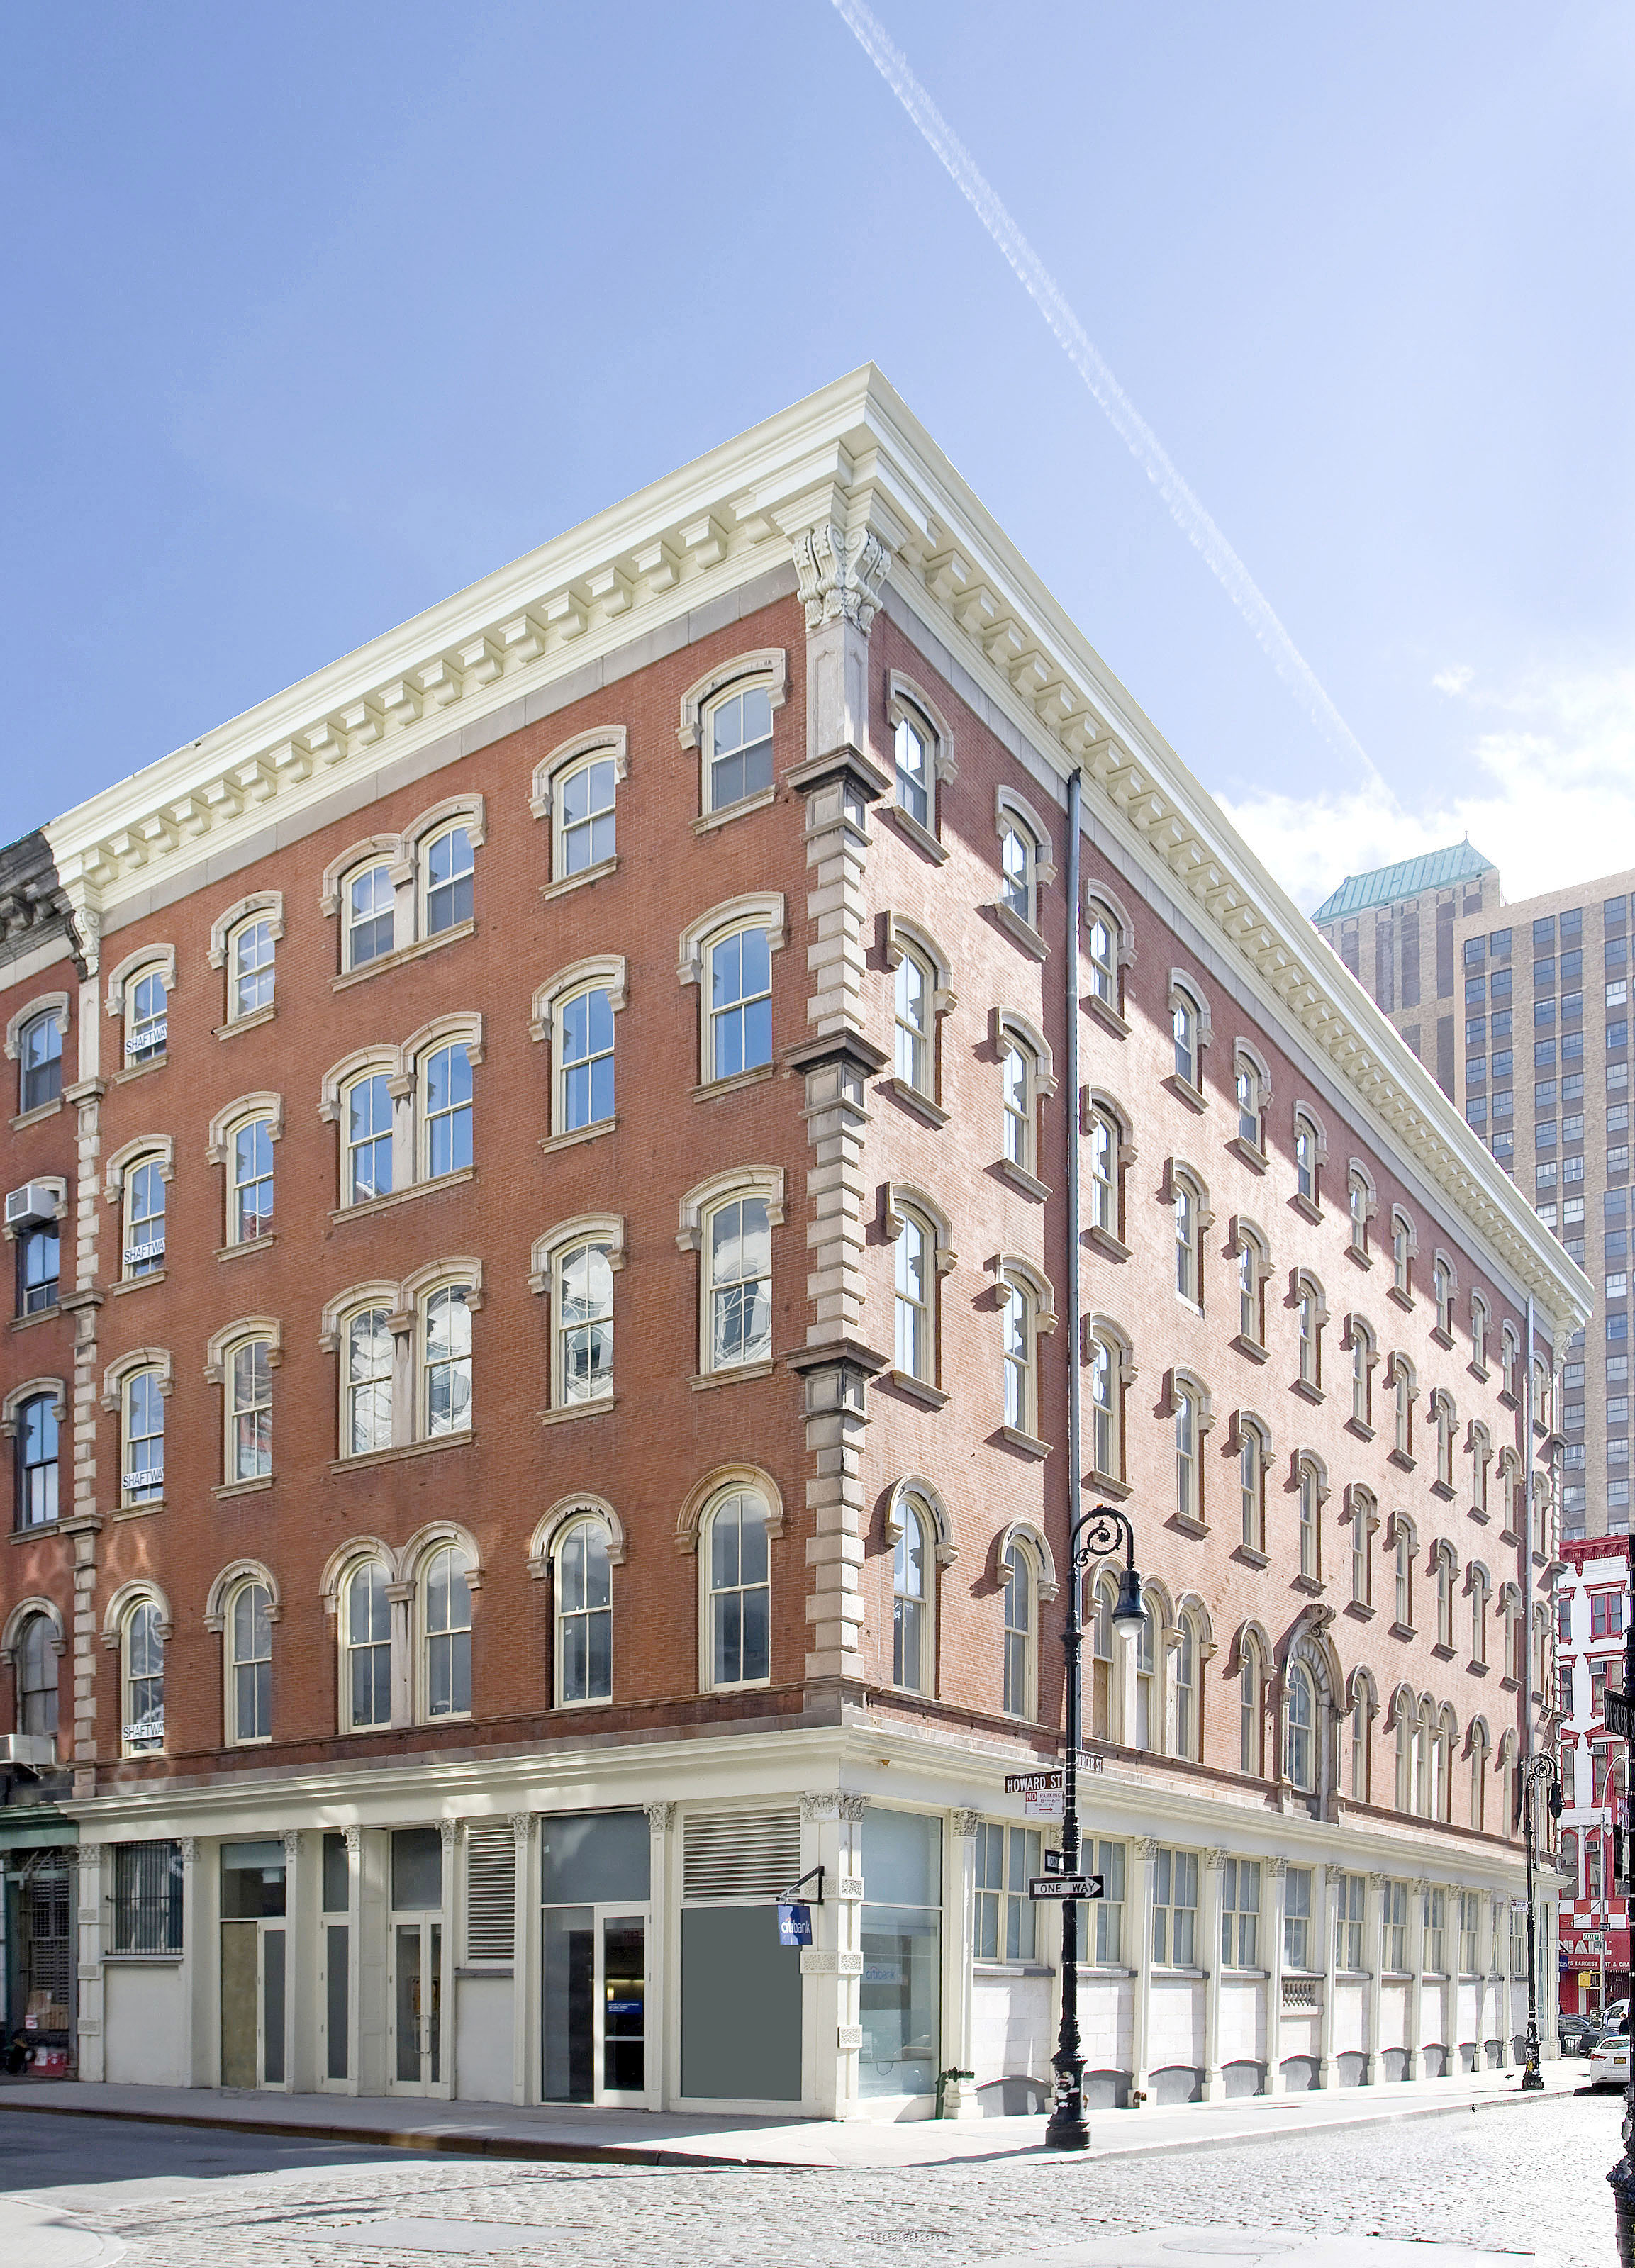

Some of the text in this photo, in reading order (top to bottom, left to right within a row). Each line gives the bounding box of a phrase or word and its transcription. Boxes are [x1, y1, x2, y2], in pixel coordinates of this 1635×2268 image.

[124, 1239, 165, 1263] SHAFTWA
[123, 1468, 164, 1487] SHAFTWA
[123, 1723, 164, 1738] SHAFTWA
[1076, 1753, 1103, 1772] MERCER ST
[1007, 1776, 1046, 1792] HOWARD
[1050, 1774, 1062, 1789] ST
[1026, 1792, 1037, 1801] NO
[1040, 1882, 1095, 1893] ONE WAY
[781, 1917, 810, 1934] citibank
